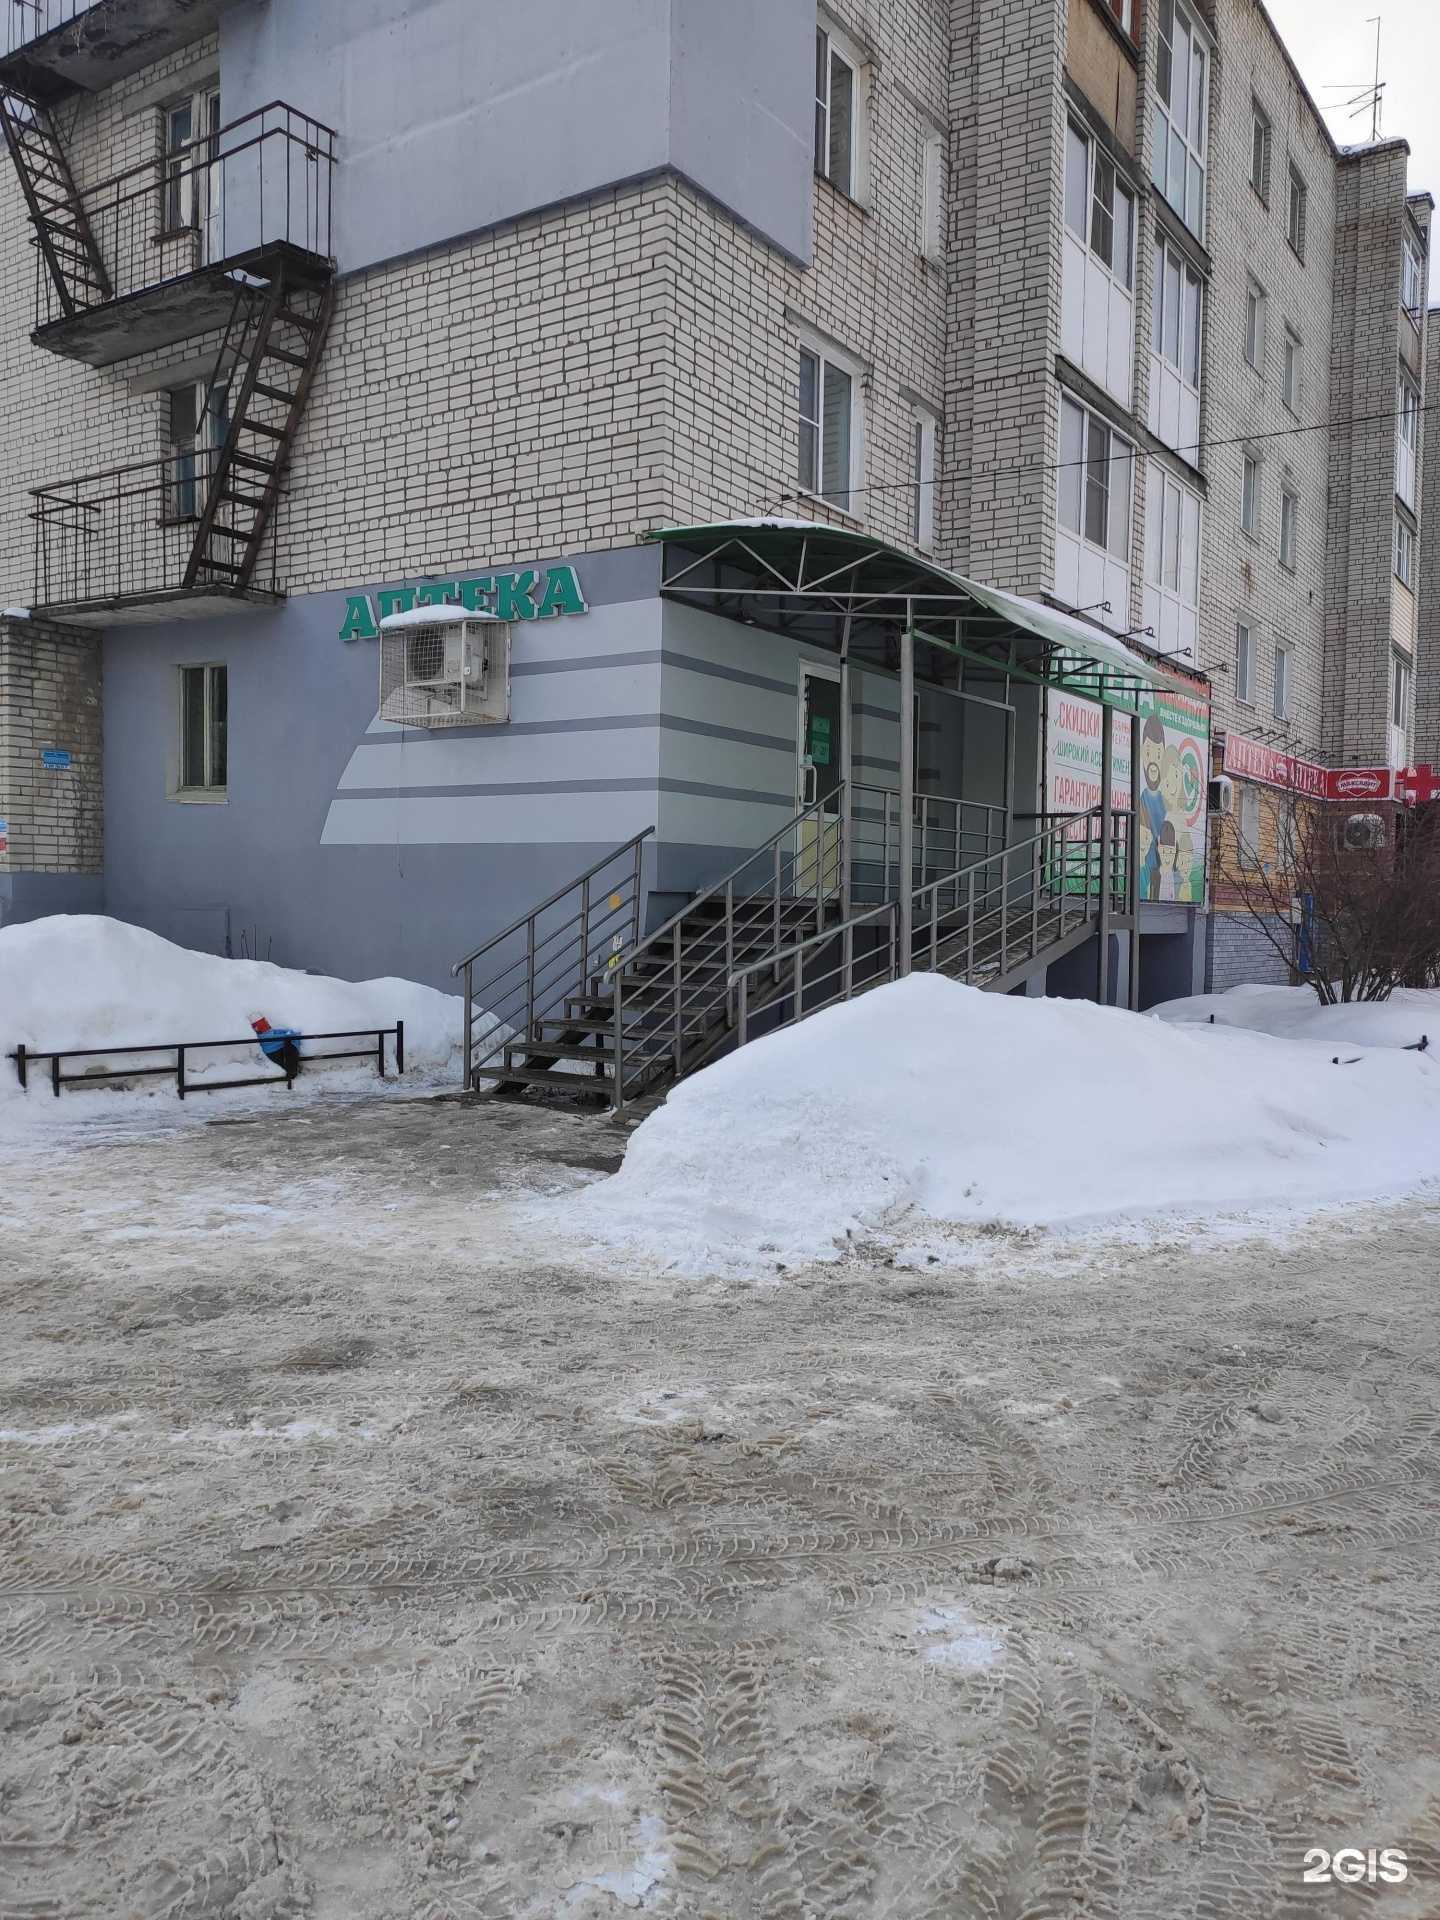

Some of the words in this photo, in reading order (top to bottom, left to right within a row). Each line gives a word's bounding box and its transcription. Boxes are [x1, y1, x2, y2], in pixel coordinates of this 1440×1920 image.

[339, 566, 588, 641] АПТЕКА
[1059, 702, 1100, 738] СКИДКИ
[1057, 739, 1089, 763] ШИРОКИЙ
